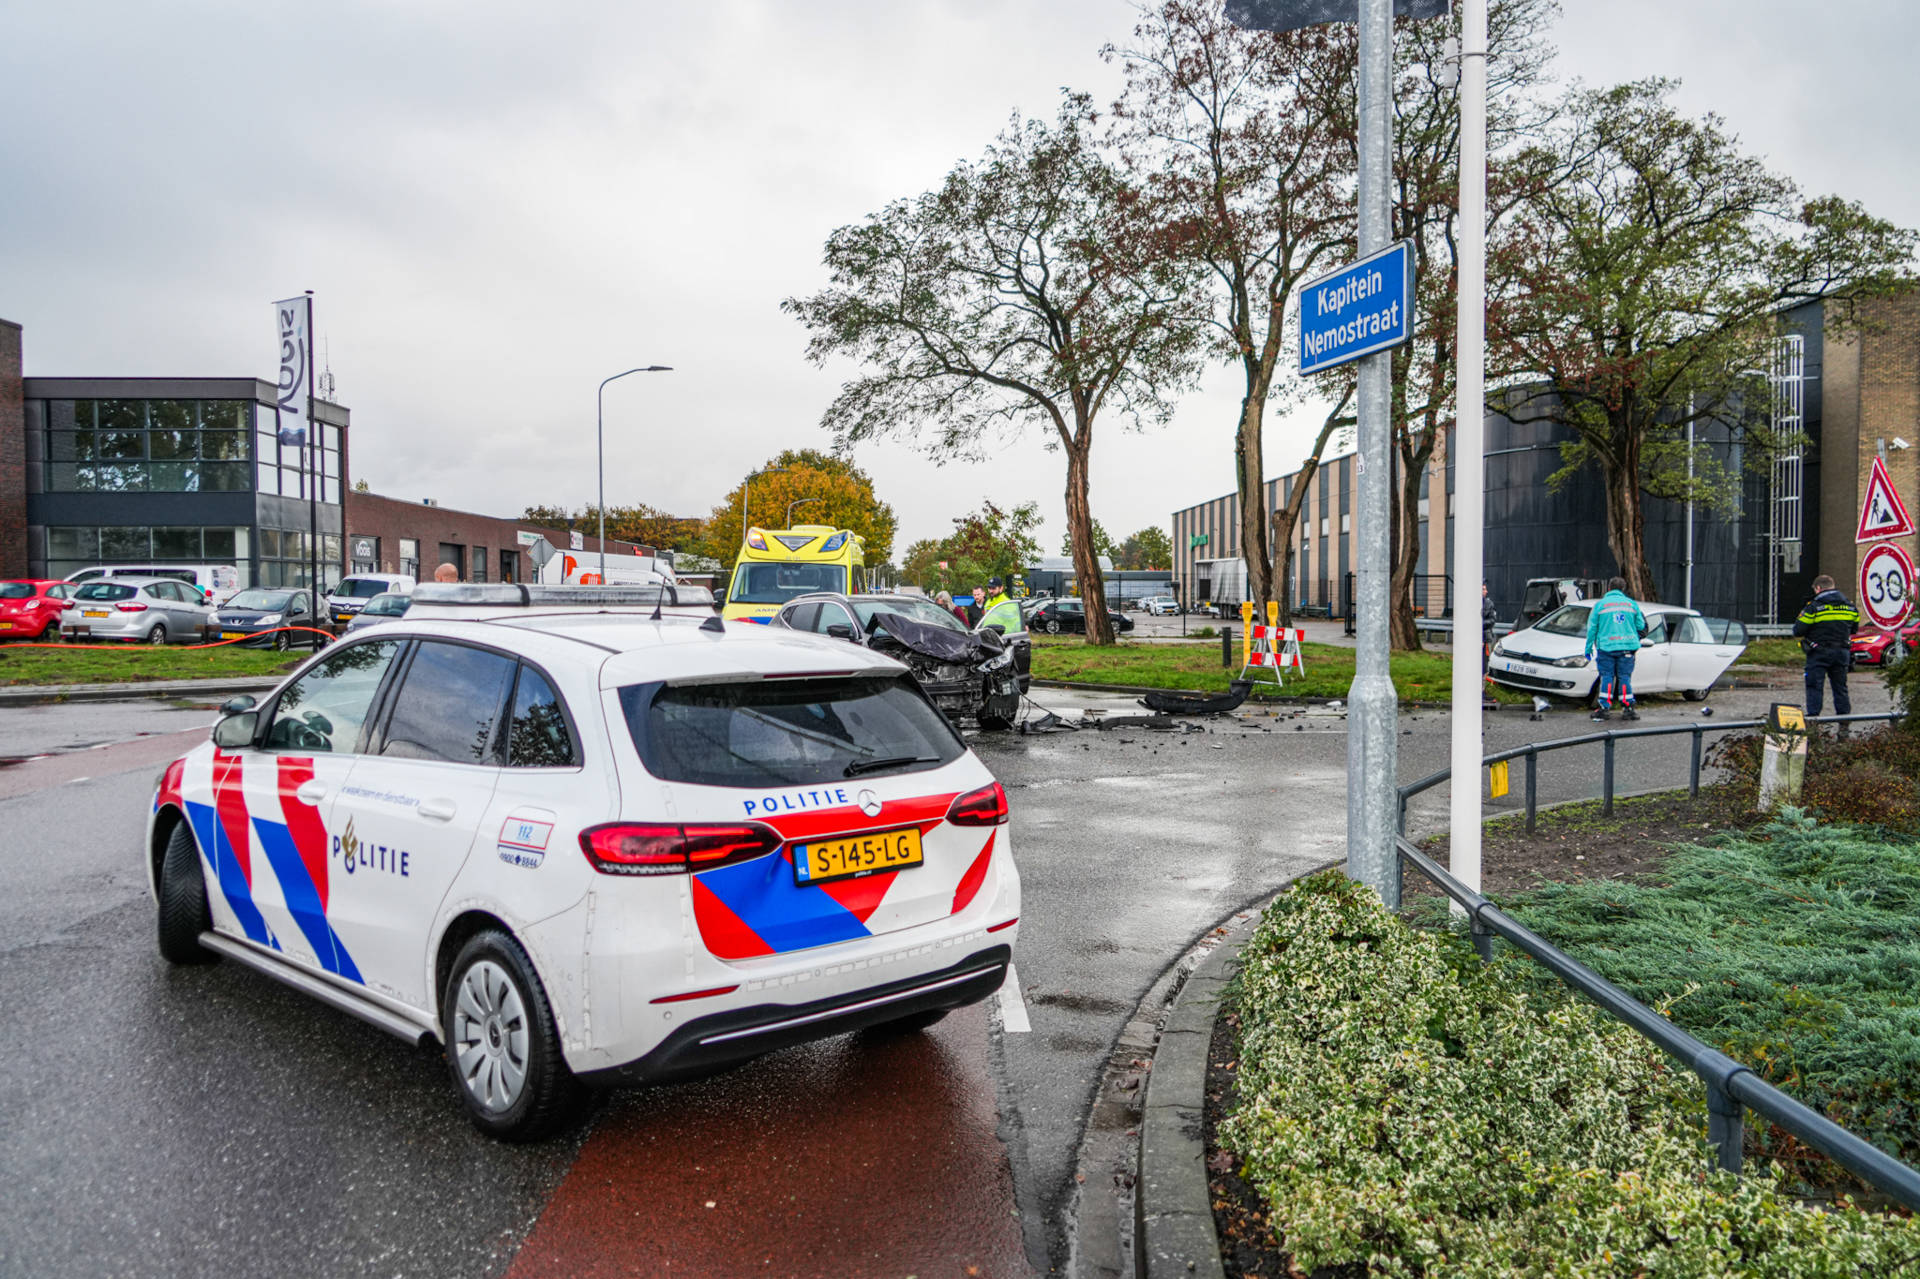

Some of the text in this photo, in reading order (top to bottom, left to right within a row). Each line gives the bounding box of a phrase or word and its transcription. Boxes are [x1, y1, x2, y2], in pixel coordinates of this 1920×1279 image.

[1317, 269, 1382, 317] Kapitein
[1304, 299, 1399, 358] Nemostraat
[1869, 569, 1904, 604] 30
[743, 788, 849, 816] POLITIE
[518, 824, 534, 839] 112
[817, 834, 910, 872] S-145-LG
[797, 866, 809, 876] NL
